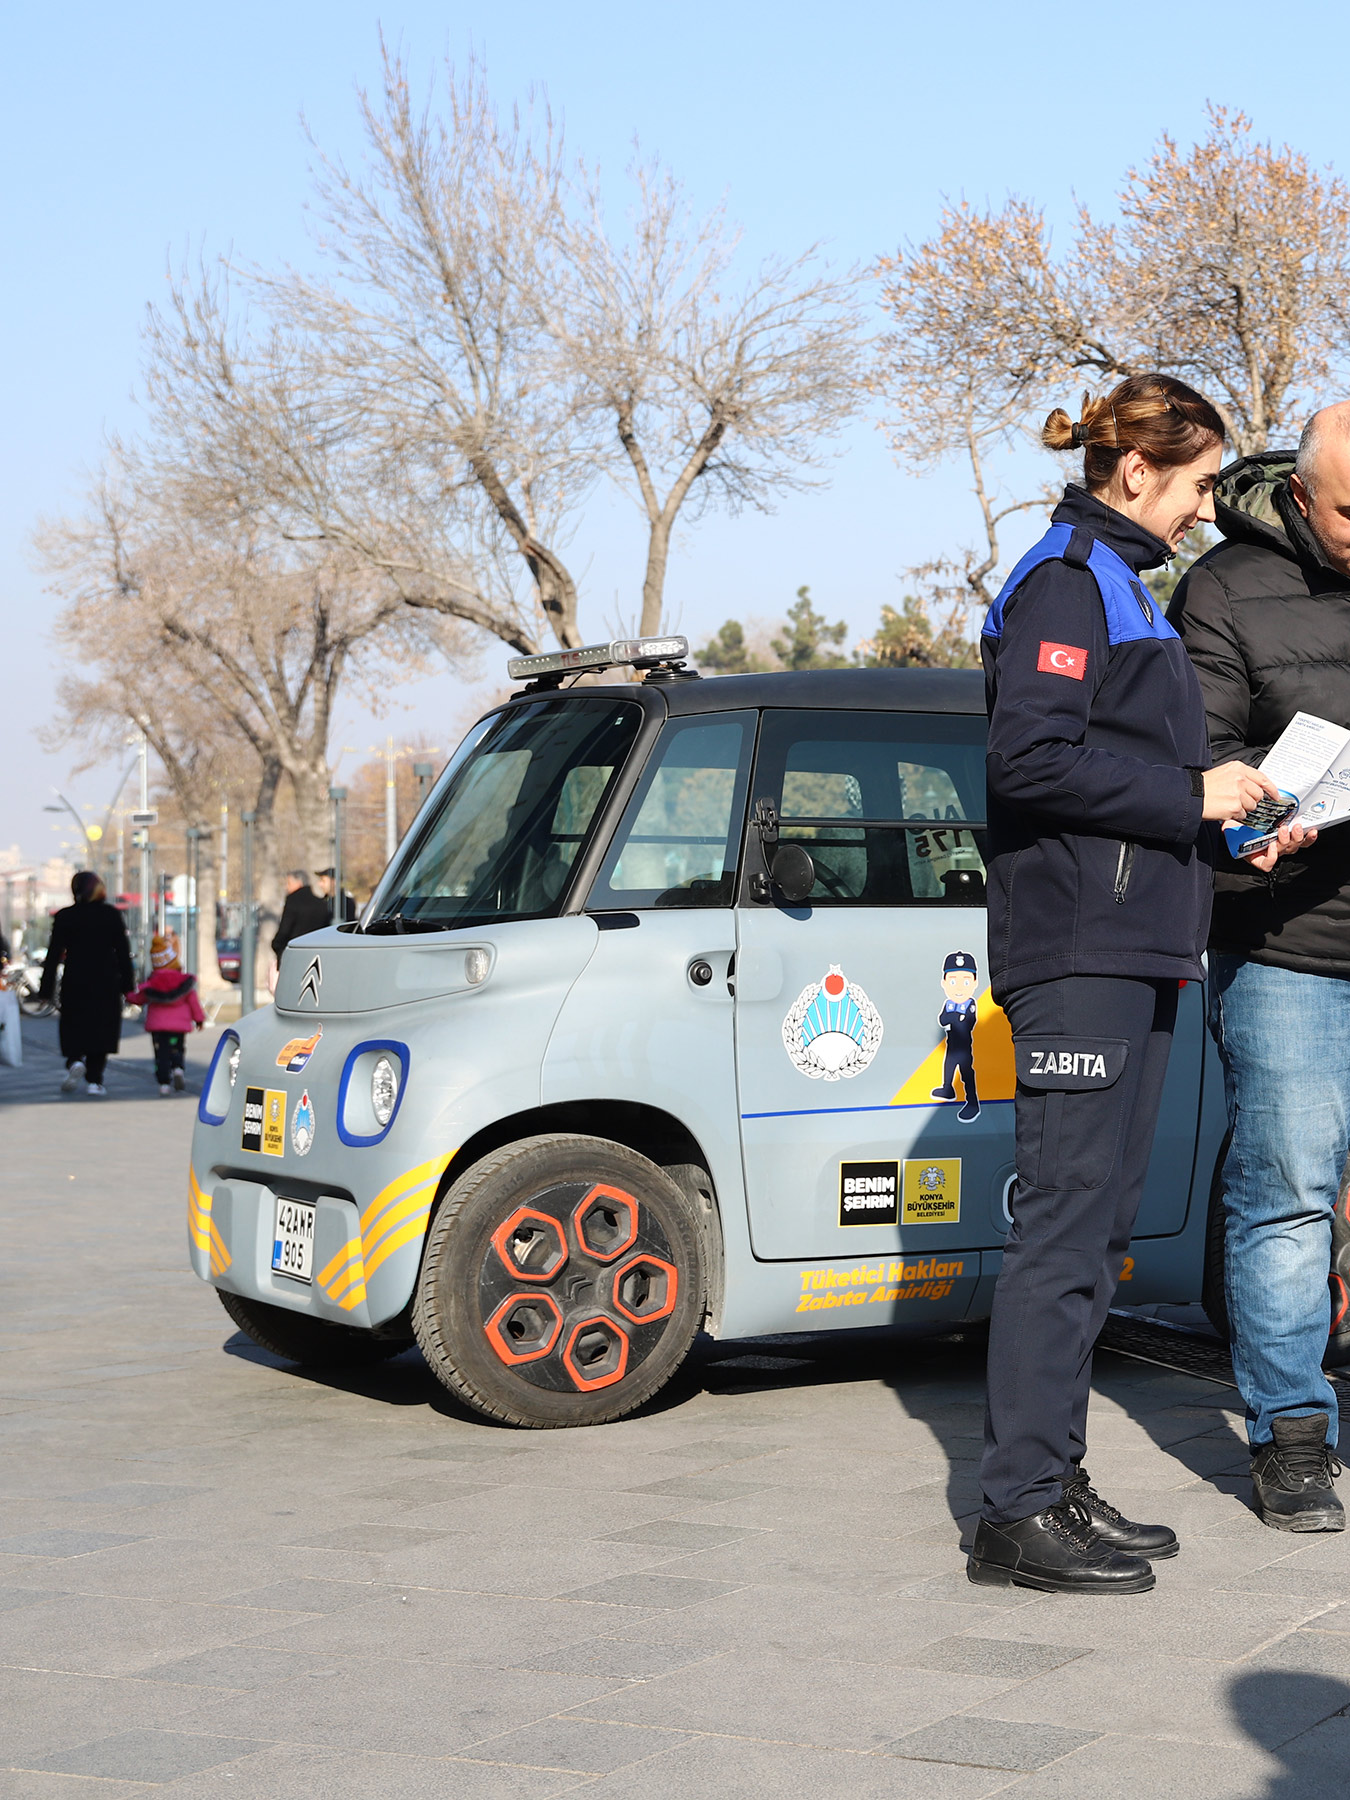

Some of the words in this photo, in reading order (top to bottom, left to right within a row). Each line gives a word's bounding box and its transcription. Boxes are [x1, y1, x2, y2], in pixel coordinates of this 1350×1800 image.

[1030, 1052, 1107, 1078] ZABITA
[844, 1176, 895, 1194] BENİM
[844, 1194, 895, 1212] ŞEHRİM
[907, 1201, 955, 1211] BÜYÜKŞEHİR
[284, 1240, 304, 1270] 905
[800, 1263, 885, 1291] Tüketici
[887, 1258, 964, 1283] Hakları
[795, 1291, 868, 1313] Zabıta
[868, 1279, 956, 1301] Amirliği
